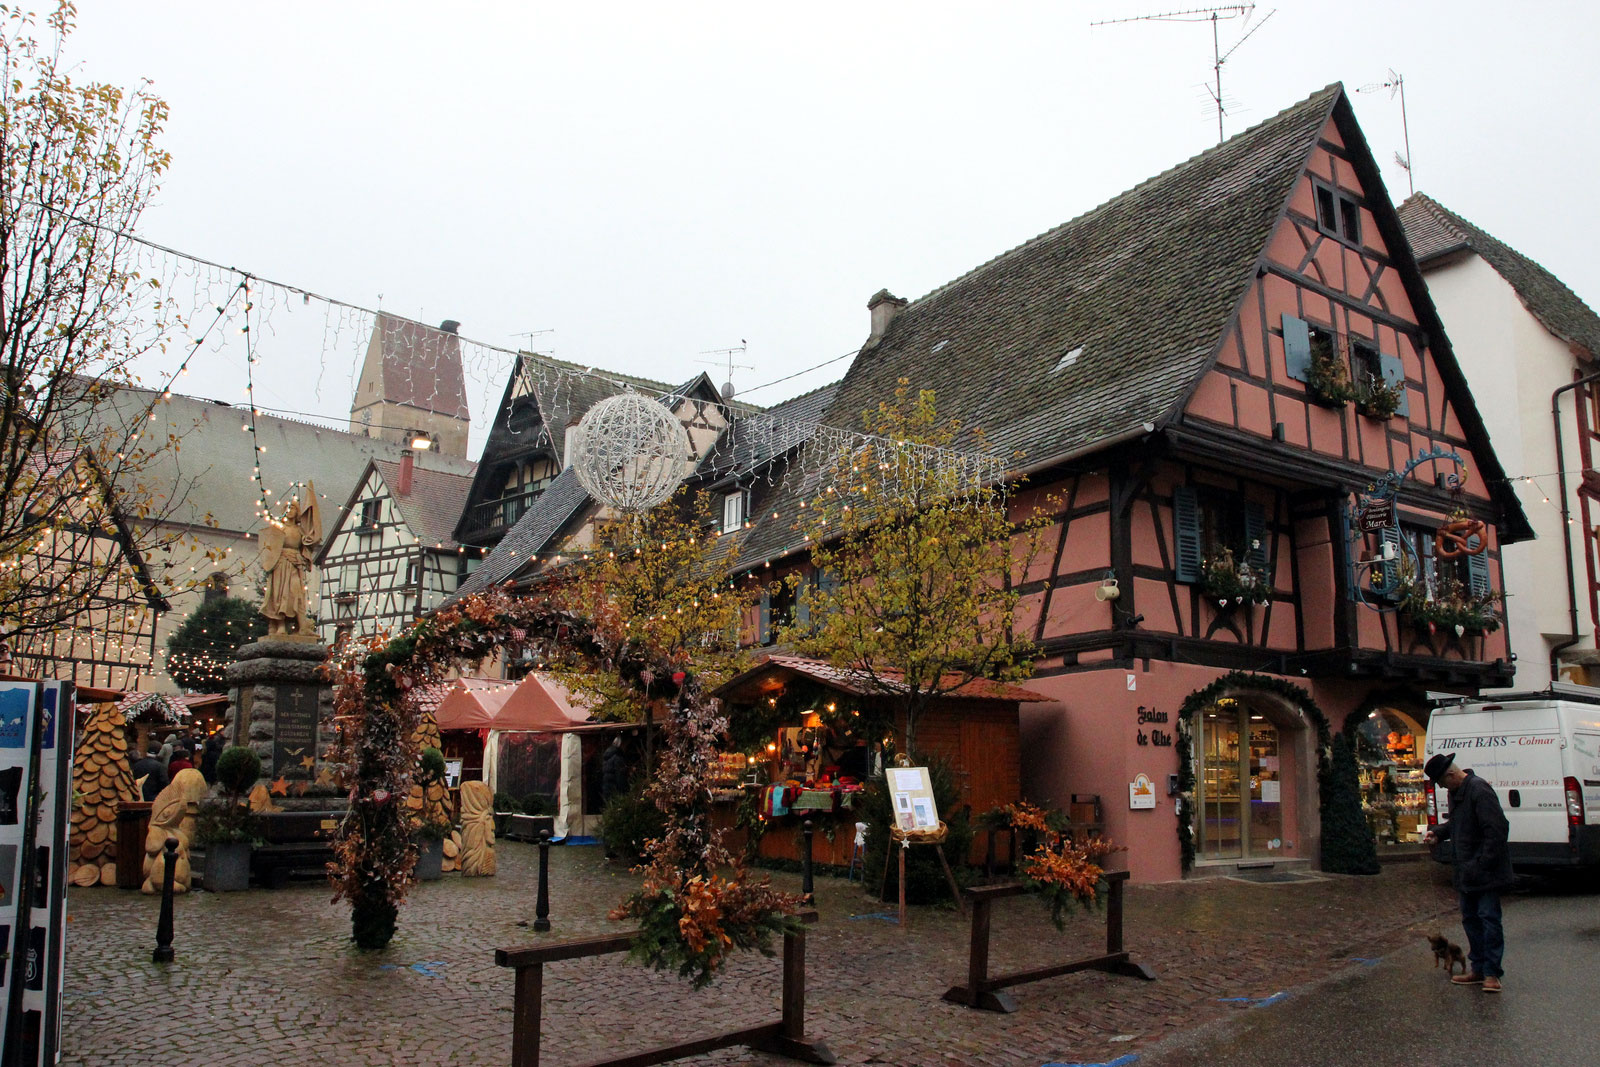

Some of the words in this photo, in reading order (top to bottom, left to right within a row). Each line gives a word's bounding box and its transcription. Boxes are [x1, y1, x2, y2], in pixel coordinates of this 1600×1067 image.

[1366, 519, 1388, 528] Marx
[1137, 705, 1168, 725] Salon
[1137, 728, 1149, 746] de
[1438, 737, 1473, 750] Albert
[1475, 736, 1508, 748] BASS
[1518, 735, 1556, 746] Colmar
